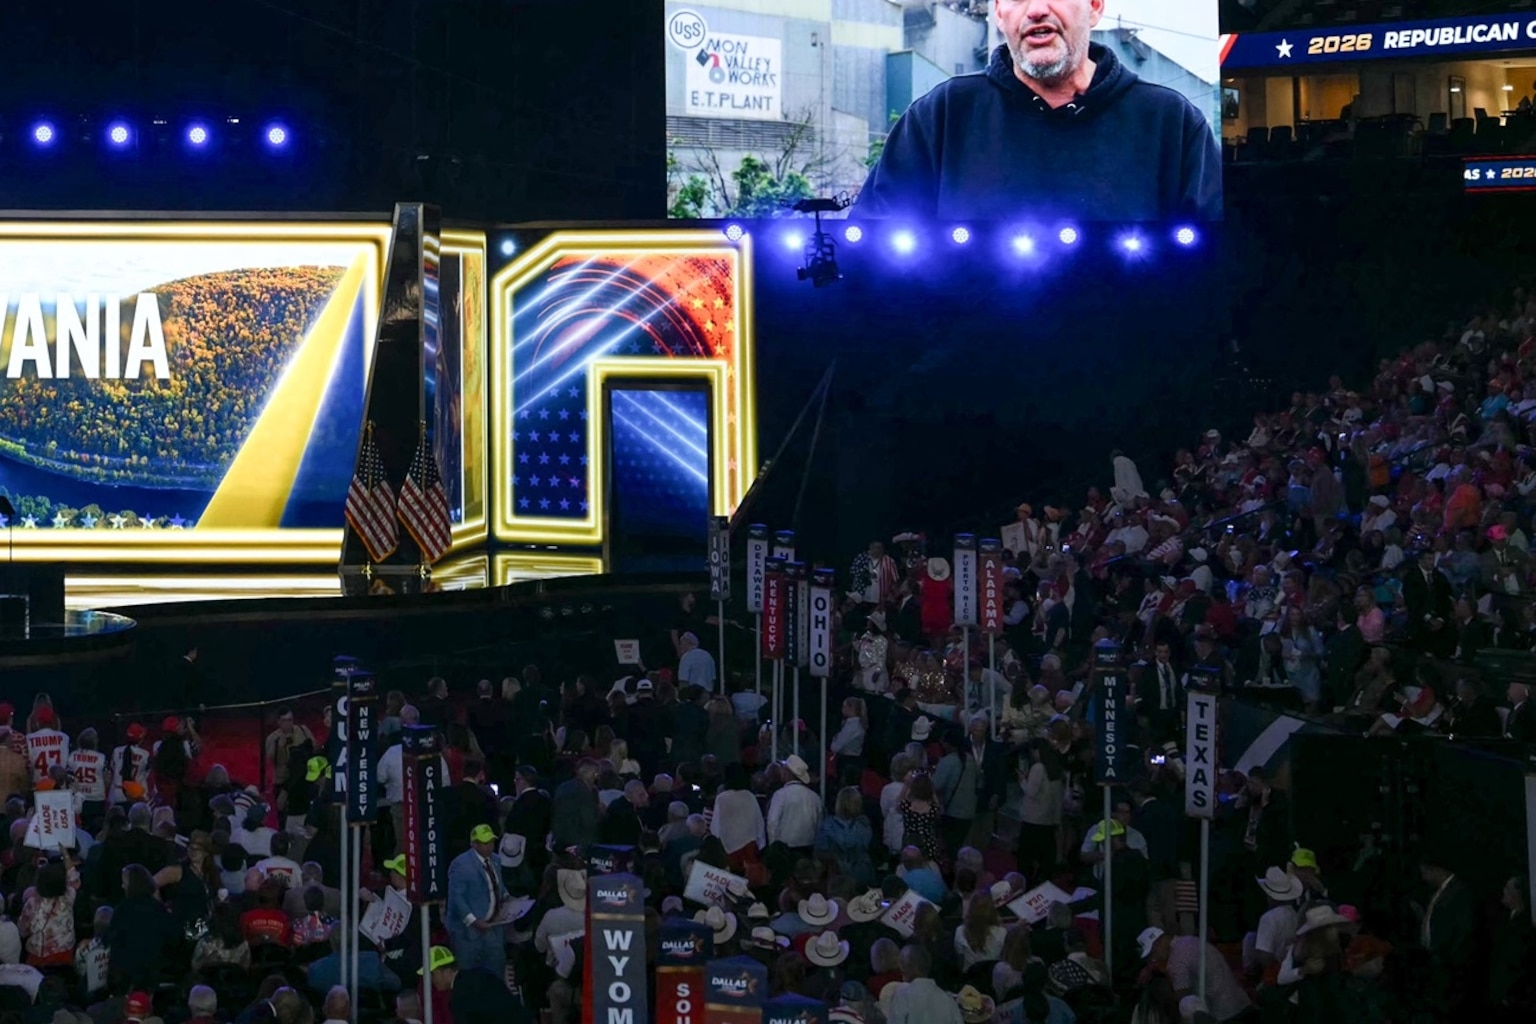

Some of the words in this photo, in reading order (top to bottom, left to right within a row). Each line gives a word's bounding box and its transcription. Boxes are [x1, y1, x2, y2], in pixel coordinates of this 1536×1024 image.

[675, 21, 701, 40] USS
[1307, 33, 1373, 55] 2026
[1383, 21, 1519, 50] REPUBLICAN
[706, 38, 748, 54] MON
[724, 55, 771, 72] VALLEY
[729, 70, 776, 87] WORKS
[1500, 167, 1536, 179] 202
[711, 536, 720, 593] IOWA
[753, 544, 763, 608] DELAWARE
[985, 560, 997, 628] ALABAMA
[768, 579, 777, 652] KENTUCKY
[814, 597, 826, 667] OHIO
[357, 706, 369, 740] NEW
[1104, 676, 1117, 777] MINNESOTA
[29, 736, 63, 749] TRUMP
[1192, 701, 1209, 807] TEXAS
[34, 750, 61, 777] 47
[72, 753, 98, 764] TRUMP
[74, 767, 97, 784] 45
[359, 747, 368, 816] JERSEY
[42, 804, 52, 835] MADE
[60, 809, 69, 829] USA
[406, 766, 416, 893] CALIFORNIA
[425, 766, 438, 894] CALIFORNIA
[590, 856, 613, 868] DALLAS
[597, 889, 627, 899] DALLAS
[703, 889, 723, 903] USA
[891, 901, 912, 923] MADE
[661, 940, 695, 950] DALLAS
[602, 929, 634, 1024] WYOM
[711, 977, 747, 989] DALLAS
